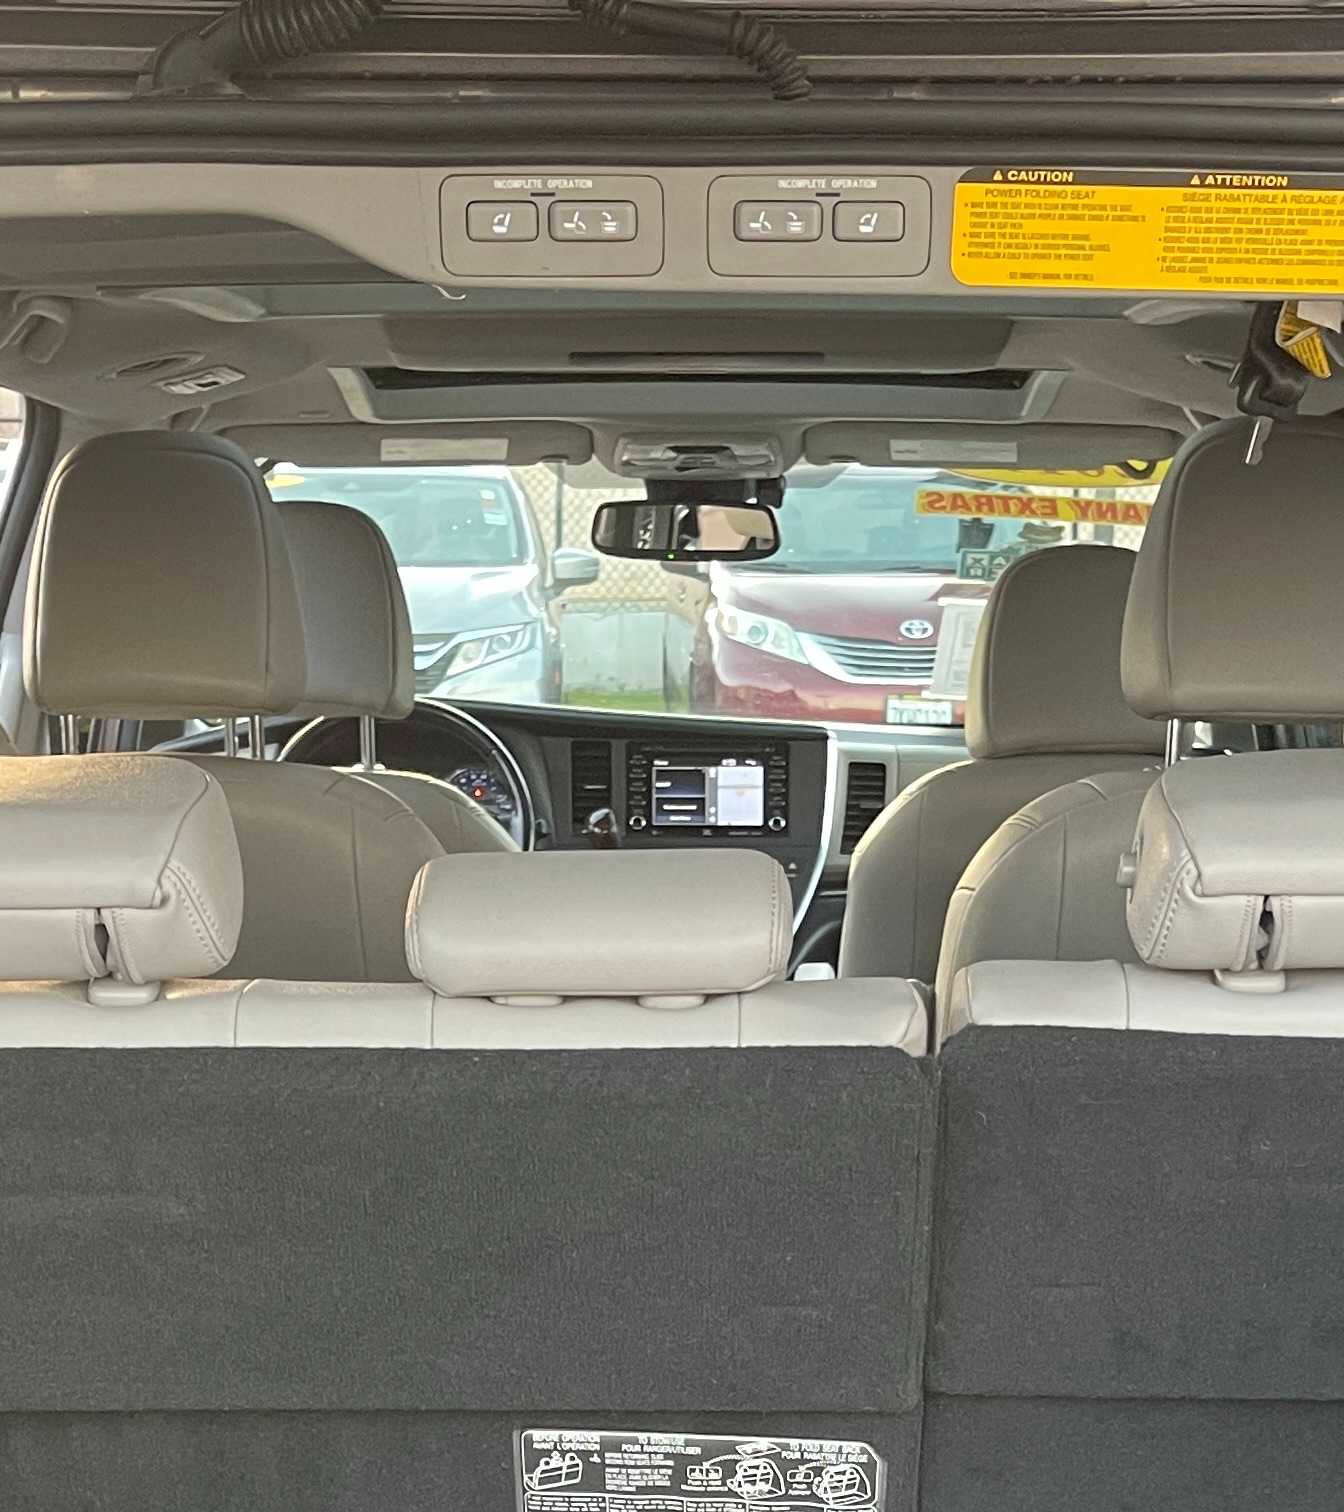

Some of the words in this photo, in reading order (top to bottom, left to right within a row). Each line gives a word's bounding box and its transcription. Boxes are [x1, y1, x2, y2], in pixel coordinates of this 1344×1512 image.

[1007, 170, 1074, 182] CAUTION
[1204, 175, 1288, 187] ATTENTION
[494, 179, 543, 189] INCOMPLETE
[547, 179, 593, 189] OPERATION
[777, 179, 826, 189] INCOMPLETE
[831, 179, 877, 189] OPERATION
[985, 188, 1023, 198] POWER
[1024, 189, 1069, 200] FOLDING
[1070, 190, 1096, 200] SEAT
